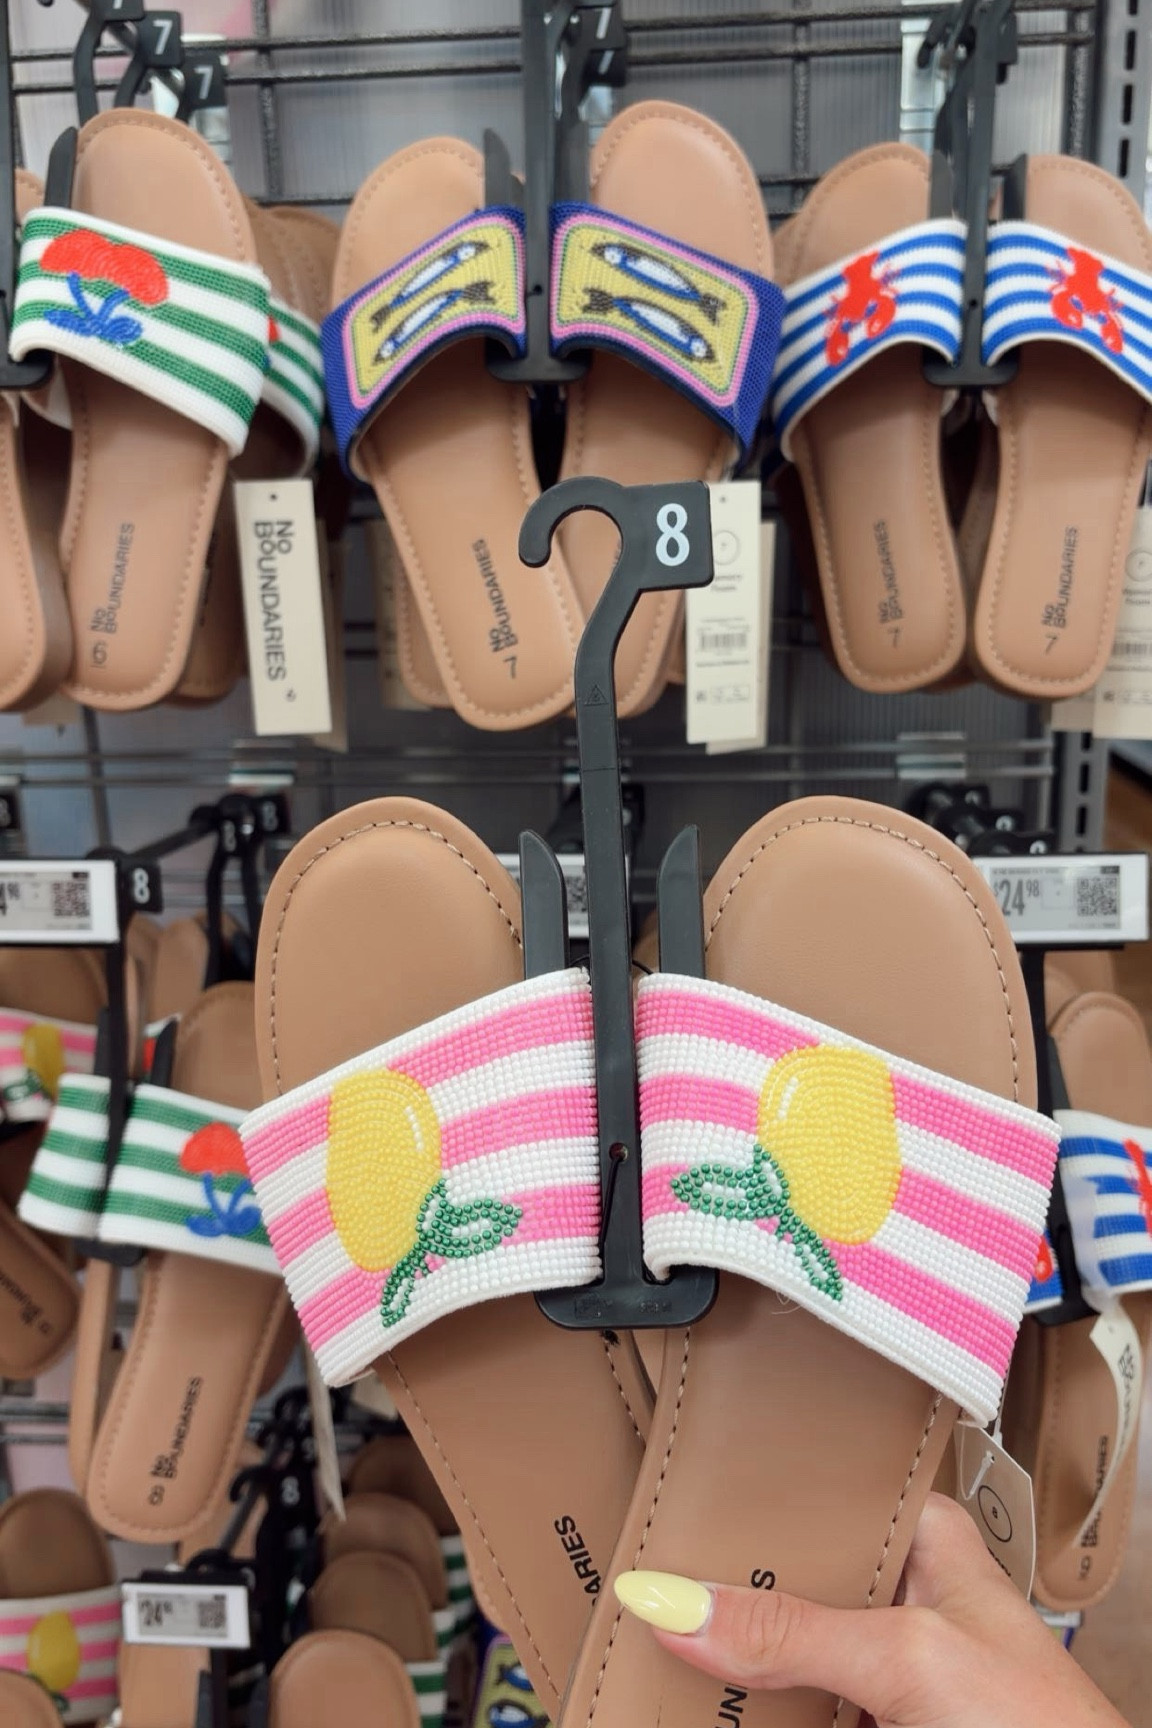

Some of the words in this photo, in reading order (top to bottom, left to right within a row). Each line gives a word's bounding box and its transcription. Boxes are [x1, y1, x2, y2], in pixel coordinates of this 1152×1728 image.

[153, 19, 173, 55] 7
[194, 65, 213, 100] 7
[276, 520, 294, 554] NO
[655, 502, 690, 567] 8
[104, 522, 135, 635] BOUNDARIES
[873, 518, 903, 620] BOUNDARIES
[1053, 526, 1078, 629] BOUNDARIES
[254, 520, 287, 682] BOUNDARIES
[472, 538, 519, 647] BOUNDARIES
[90, 608, 106, 633] NO
[488, 628, 504, 653] NO
[503, 654, 518, 680] 7
[133, 867, 150, 904] 8
